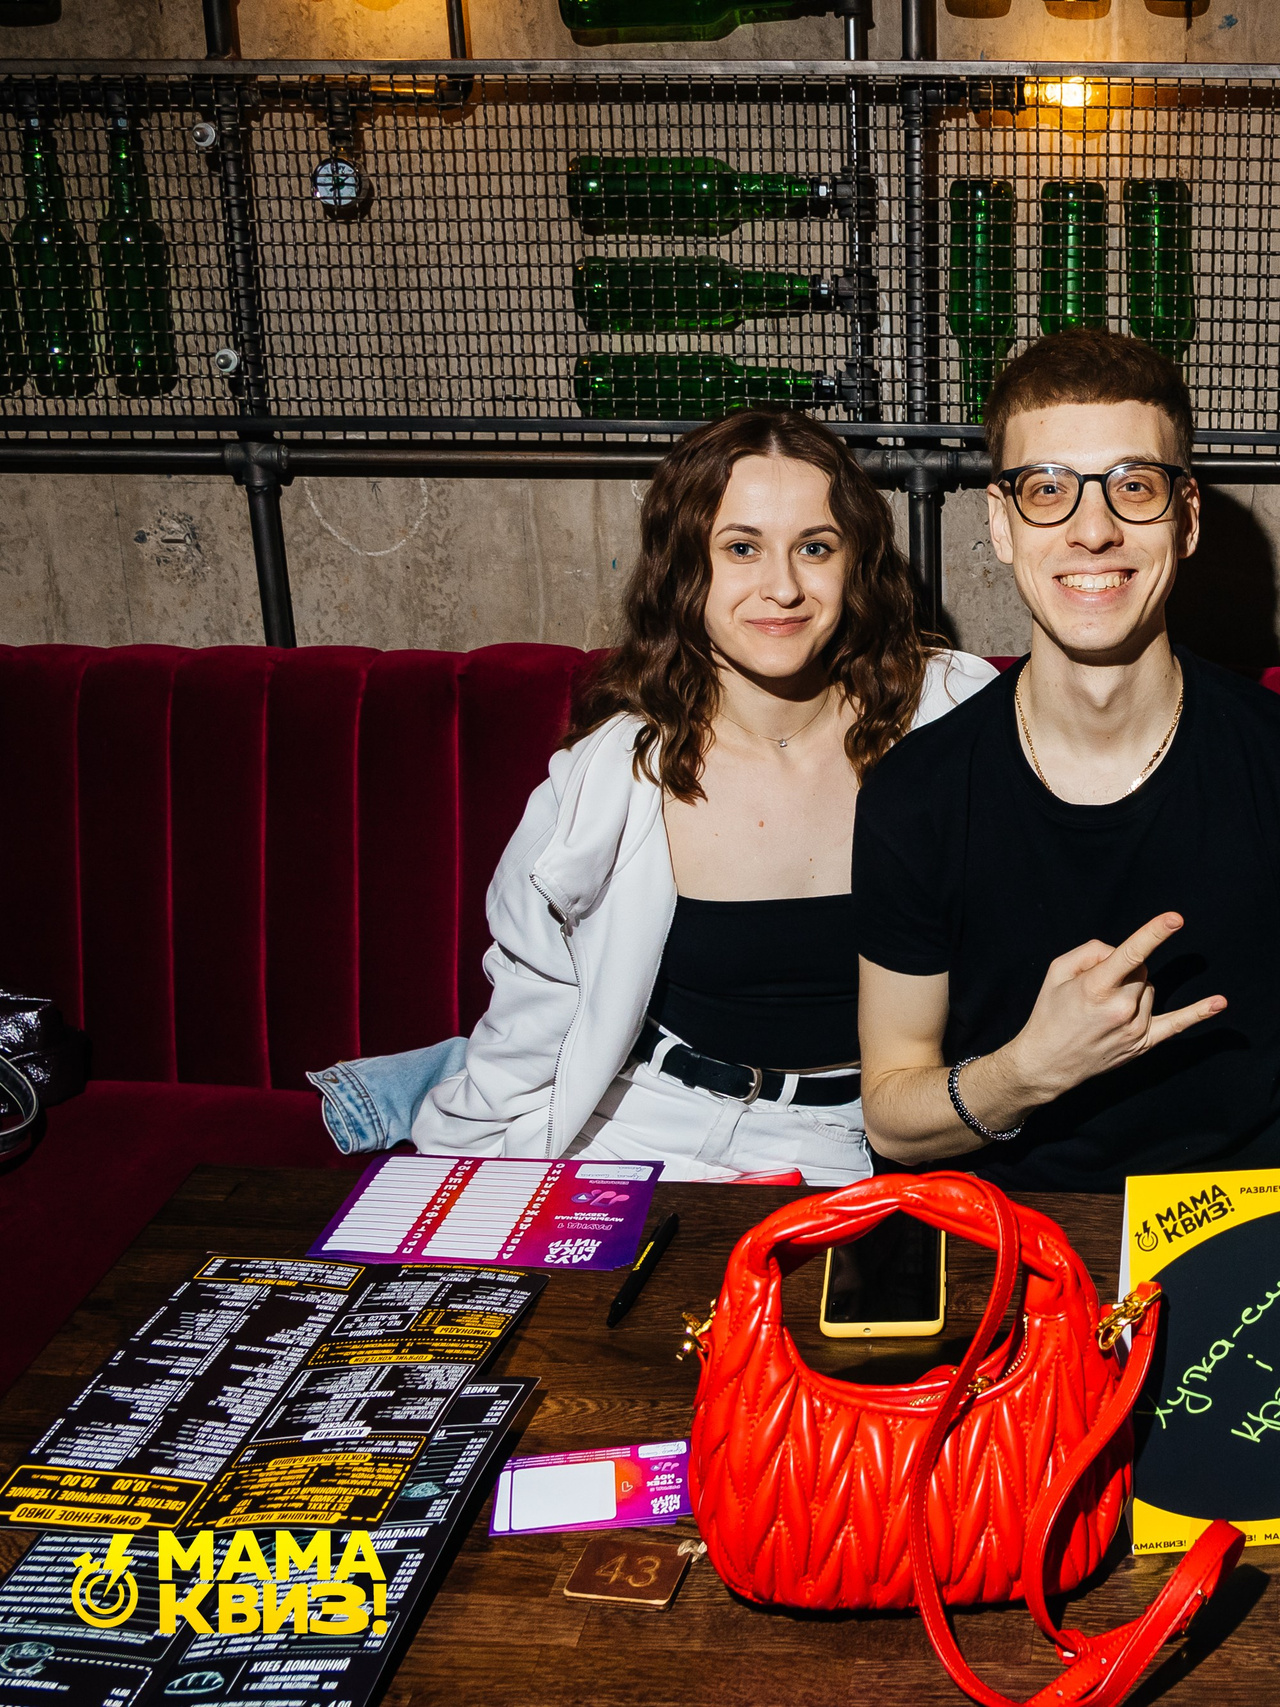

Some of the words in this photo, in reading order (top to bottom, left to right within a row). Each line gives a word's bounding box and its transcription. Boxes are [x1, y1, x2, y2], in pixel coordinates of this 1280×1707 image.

[1155, 1183, 1228, 1229] МАМА
[1163, 1196, 1237, 1244] КВИЗ!
[547, 1238, 602, 1249] ЛИТИ
[548, 1245, 596, 1255] ЫКА
[543, 1253, 590, 1264] МУЗ
[348, 1328, 386, 1336] SANGRIA
[438, 1327, 495, 1336] ЛИМОНАДЫ
[330, 1390, 396, 1400] КЛАССИЧЕСКИЕ
[462, 1386, 499, 1394] ДВИЧИ
[229, 1416, 257, 1424] ВИСКИ
[317, 1419, 367, 1429] АВТОРСКИЕ
[309, 1429, 363, 1439] КОКТЕЙЛИ
[304, 1453, 369, 1465] КОКТЕЙЛЬНАЯ
[5, 1486, 51, 1500] ТЁМНОЕ
[284, 1487, 301, 1495] СЕТ
[301, 1486, 382, 1496] ДЕГУСТАЦИОННЫЙ
[58, 1490, 127, 1504] ПШЕНИЧНОЕ
[311, 1494, 338, 1503] ZAVOD
[336, 1495, 354, 1503] СЕТ
[134, 1496, 186, 1510] СВЕТЛОЕ
[308, 1502, 332, 1511] XXXL
[331, 1503, 349, 1511] СЕТ
[16, 1507, 56, 1520] ПИВО
[58, 1510, 141, 1526] ФИРМЕННОЕ
[273, 1512, 333, 1522] ДОМАШНИЕ
[223, 1513, 275, 1525] НАСТОЙКИ
[340, 1527, 429, 1543] НОНАЛЬНАЯ
[594, 1553, 661, 1587] 43
[249, 1661, 282, 1673] ХЛЕБ
[280, 1657, 351, 1672] ДОМАШНИЙ
